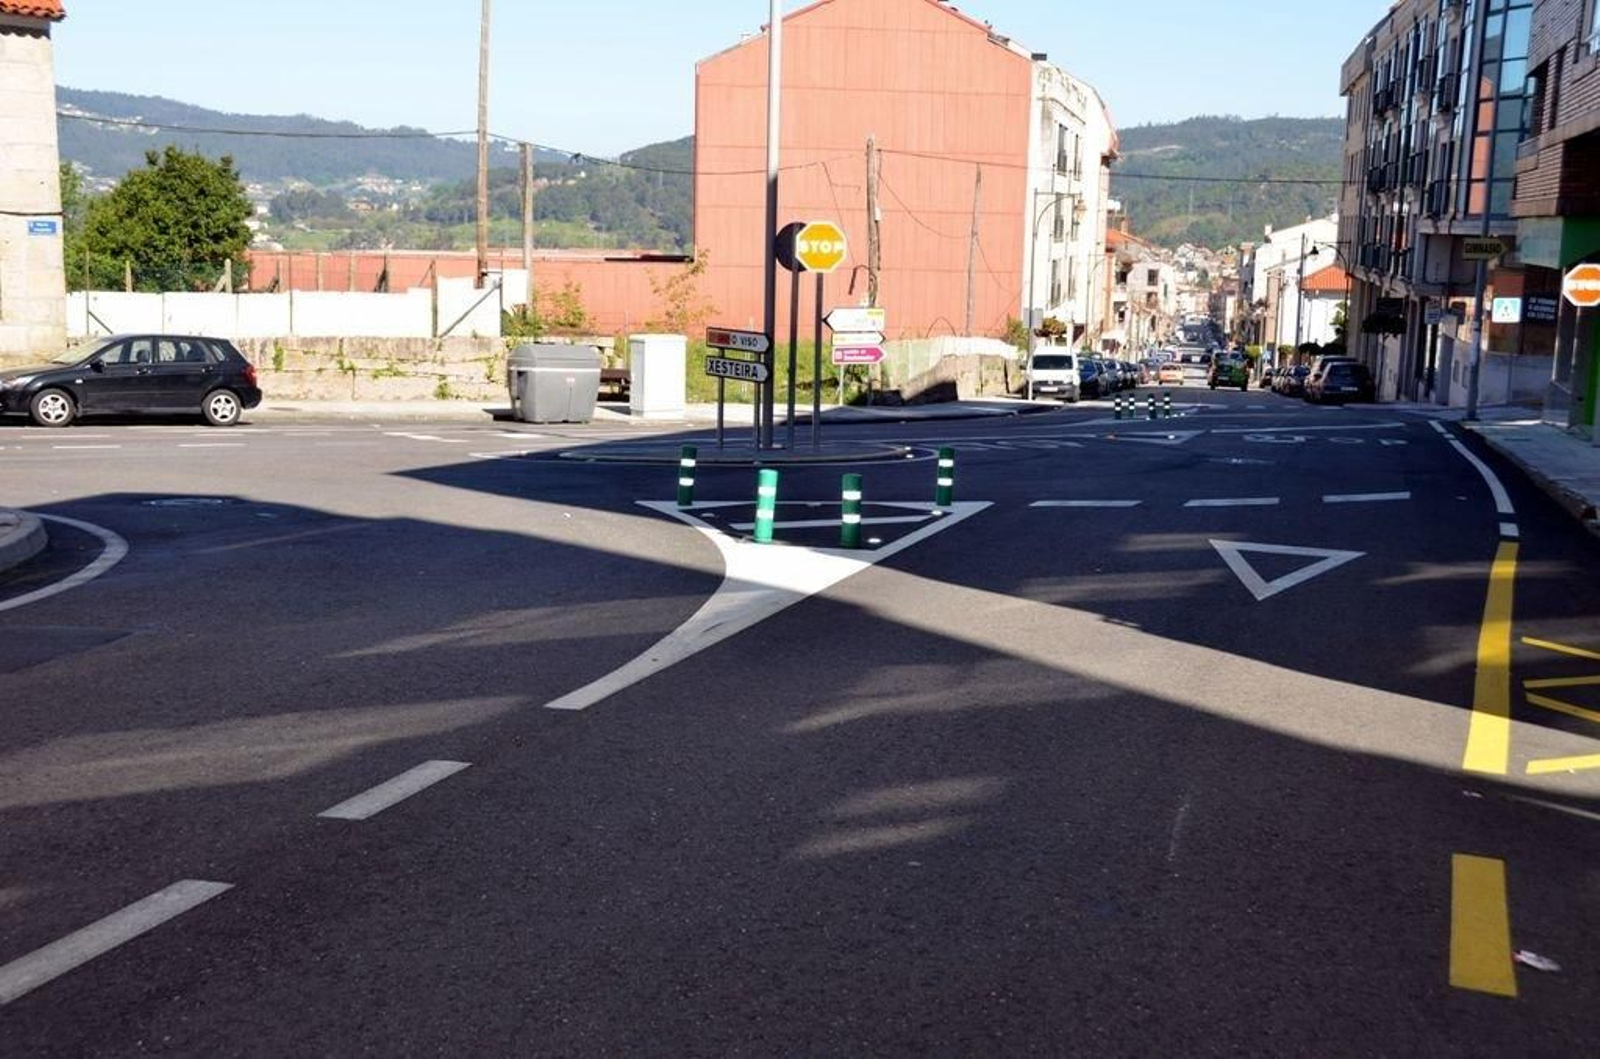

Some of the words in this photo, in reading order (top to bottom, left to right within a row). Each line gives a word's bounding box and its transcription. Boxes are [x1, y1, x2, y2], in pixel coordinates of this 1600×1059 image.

[799, 240, 844, 254] STOP
[731, 334, 737, 345] O
[740, 335, 758, 347] VISO
[708, 360, 759, 379] XESTEIRA
